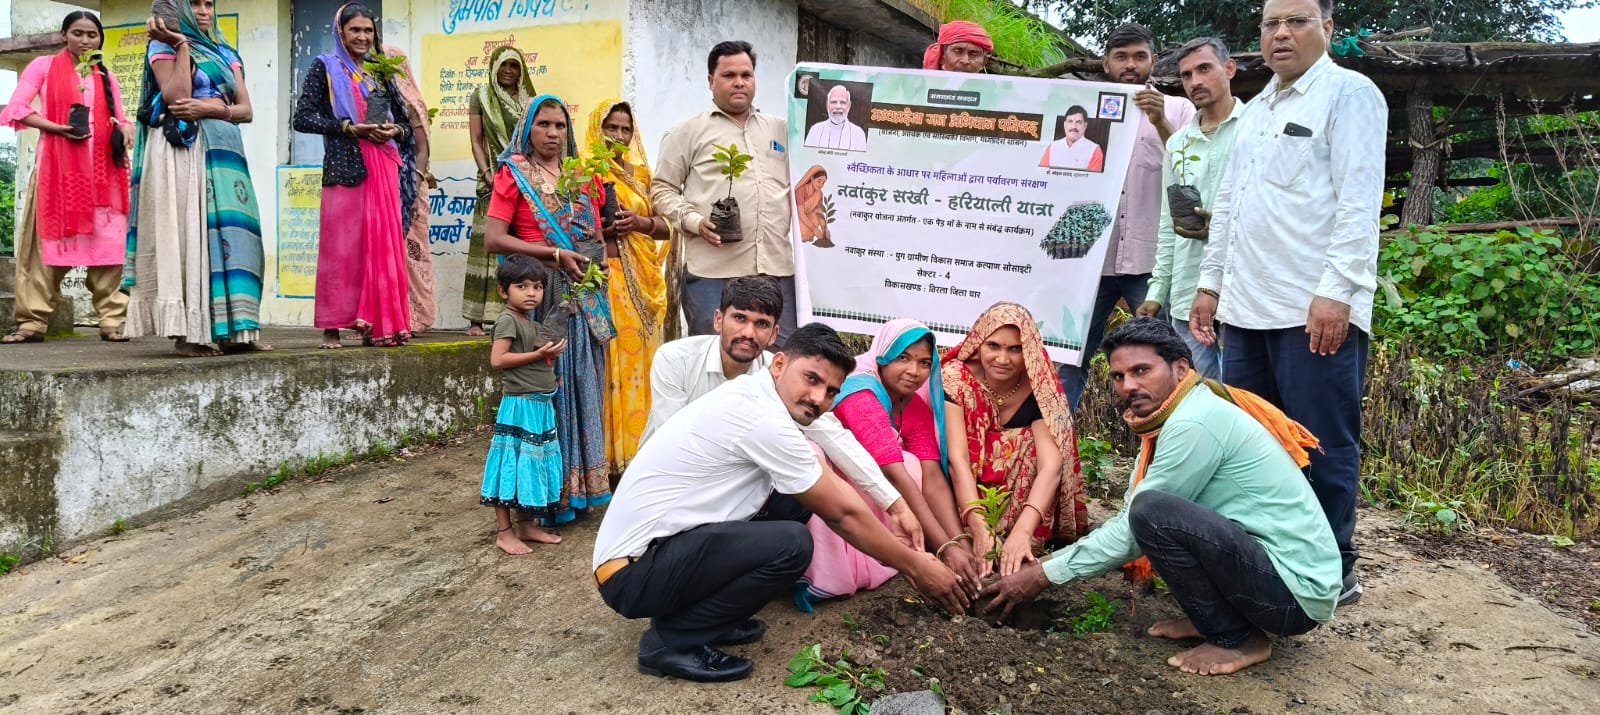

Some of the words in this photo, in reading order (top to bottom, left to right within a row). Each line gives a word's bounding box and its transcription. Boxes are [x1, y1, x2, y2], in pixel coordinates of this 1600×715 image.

[925, 113, 948, 127] जन
[949, 111, 997, 131] अभियान
[846, 161, 885, 175] स्वैच्छिकता
[886, 165, 895, 176] के
[896, 168, 919, 178] आधार
[921, 170, 931, 179] पर
[933, 169, 967, 182] महिलाओं
[968, 174, 985, 184] द्वारा
[987, 175, 1018, 187] पर्यावरण
[1020, 179, 1049, 189] संरक्षण
[837, 182, 888, 206] नवांकुर
[893, 187, 930, 205] सखी
[948, 191, 1012, 213] हरियाली
[1017, 200, 1055, 217] यात्रा
[874, 211, 895, 222] योजना
[923, 217, 934, 226] एक
[956, 220, 963, 229] के
[964, 221, 977, 230] नाम
[978, 220, 985, 231] से
[1004, 225, 1035, 237] कार्यक्रम)
[867, 248, 885, 258] संस्था
[907, 251, 929, 263] ग्रामीण
[930, 254, 953, 265] विकास
[954, 258, 974, 268] समाज
[976, 260, 1001, 271] कल्याण
[1002, 261, 1032, 274] सोसाइटी
[916, 267, 937, 279] सेक्टर
[945, 271, 951, 280] 4
[884, 278, 922, 292] विकासखण्ड
[928, 283, 948, 295] तिरला
[950, 285, 967, 297] जिला
